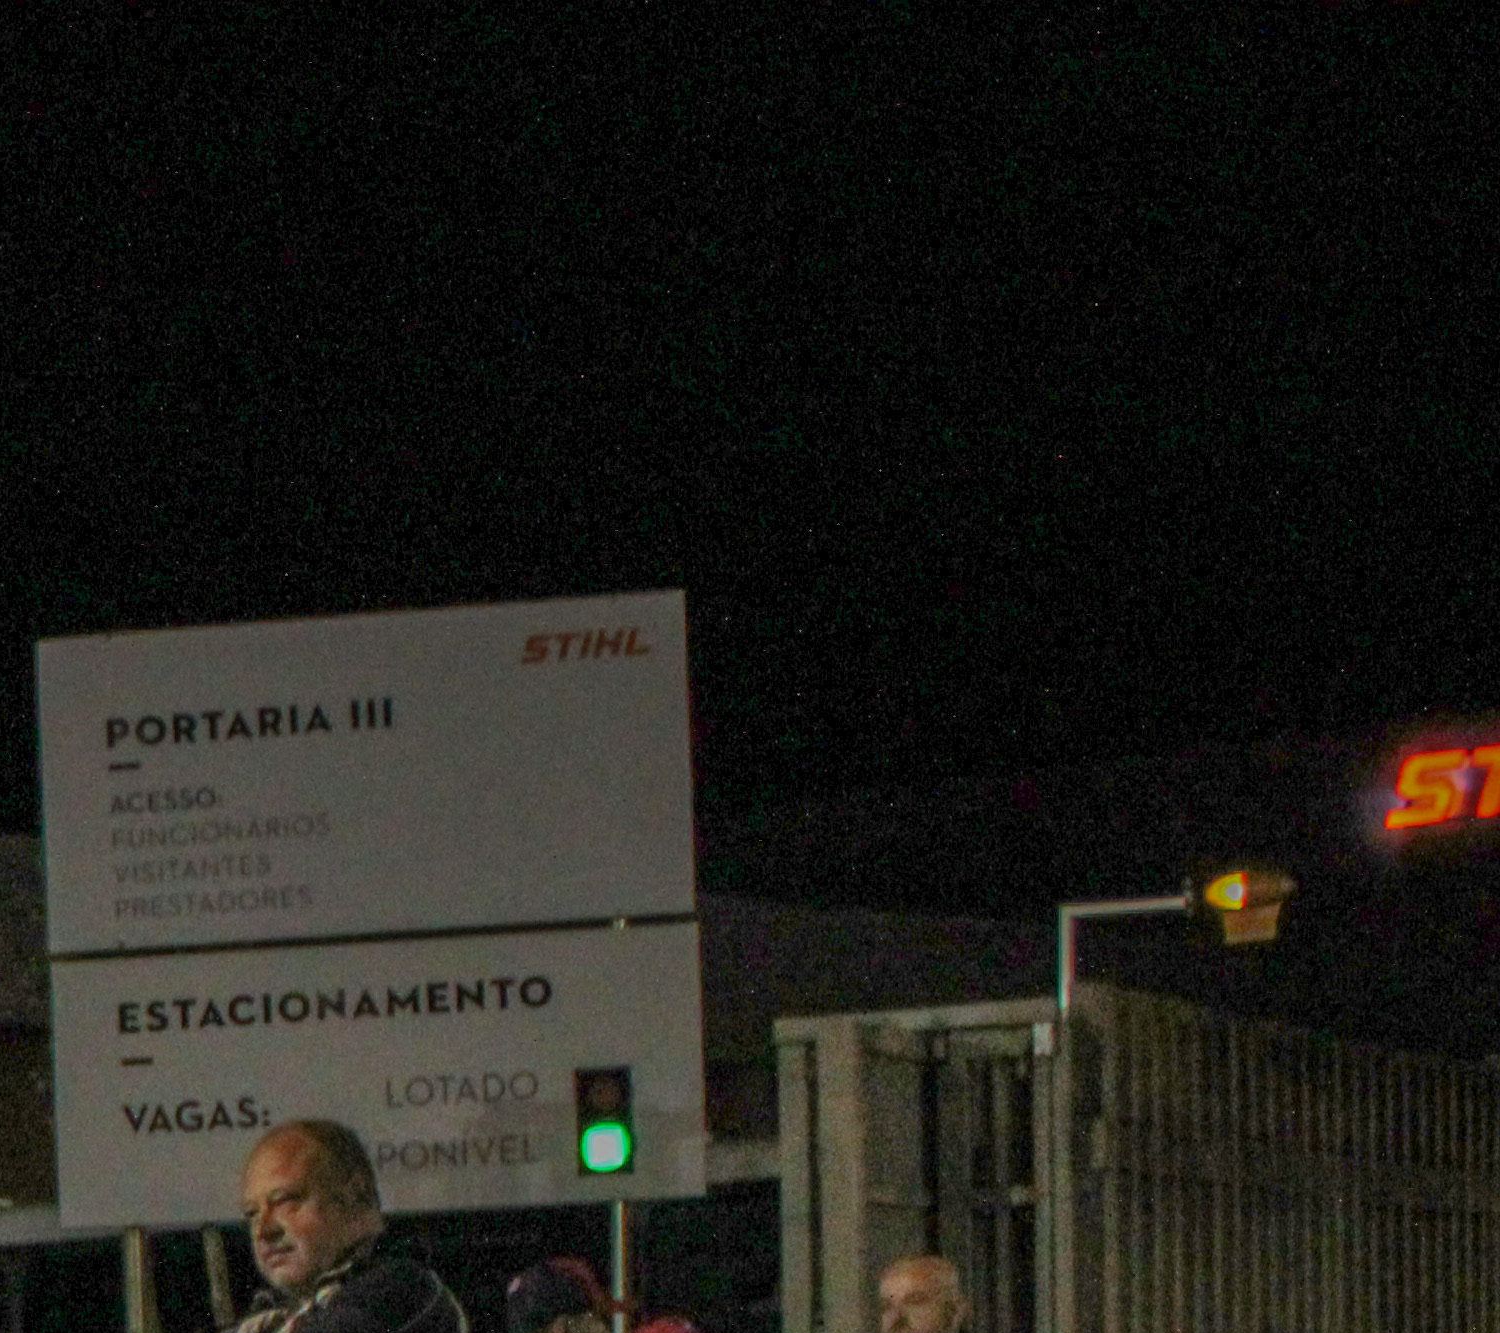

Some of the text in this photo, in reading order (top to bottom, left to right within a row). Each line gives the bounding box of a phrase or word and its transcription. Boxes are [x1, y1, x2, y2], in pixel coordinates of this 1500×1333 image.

[521, 627, 651, 665] STIHL
[106, 698, 395, 748] PORTARIA III
[110, 785, 218, 815] ACESSO
[113, 852, 272, 886] VISITANTES
[114, 884, 313, 919] PRESTADORES
[118, 975, 553, 1036] ESTACIONAMENTO
[384, 1071, 540, 1110] LOTADO
[123, 1097, 272, 1134] VAGAS:
